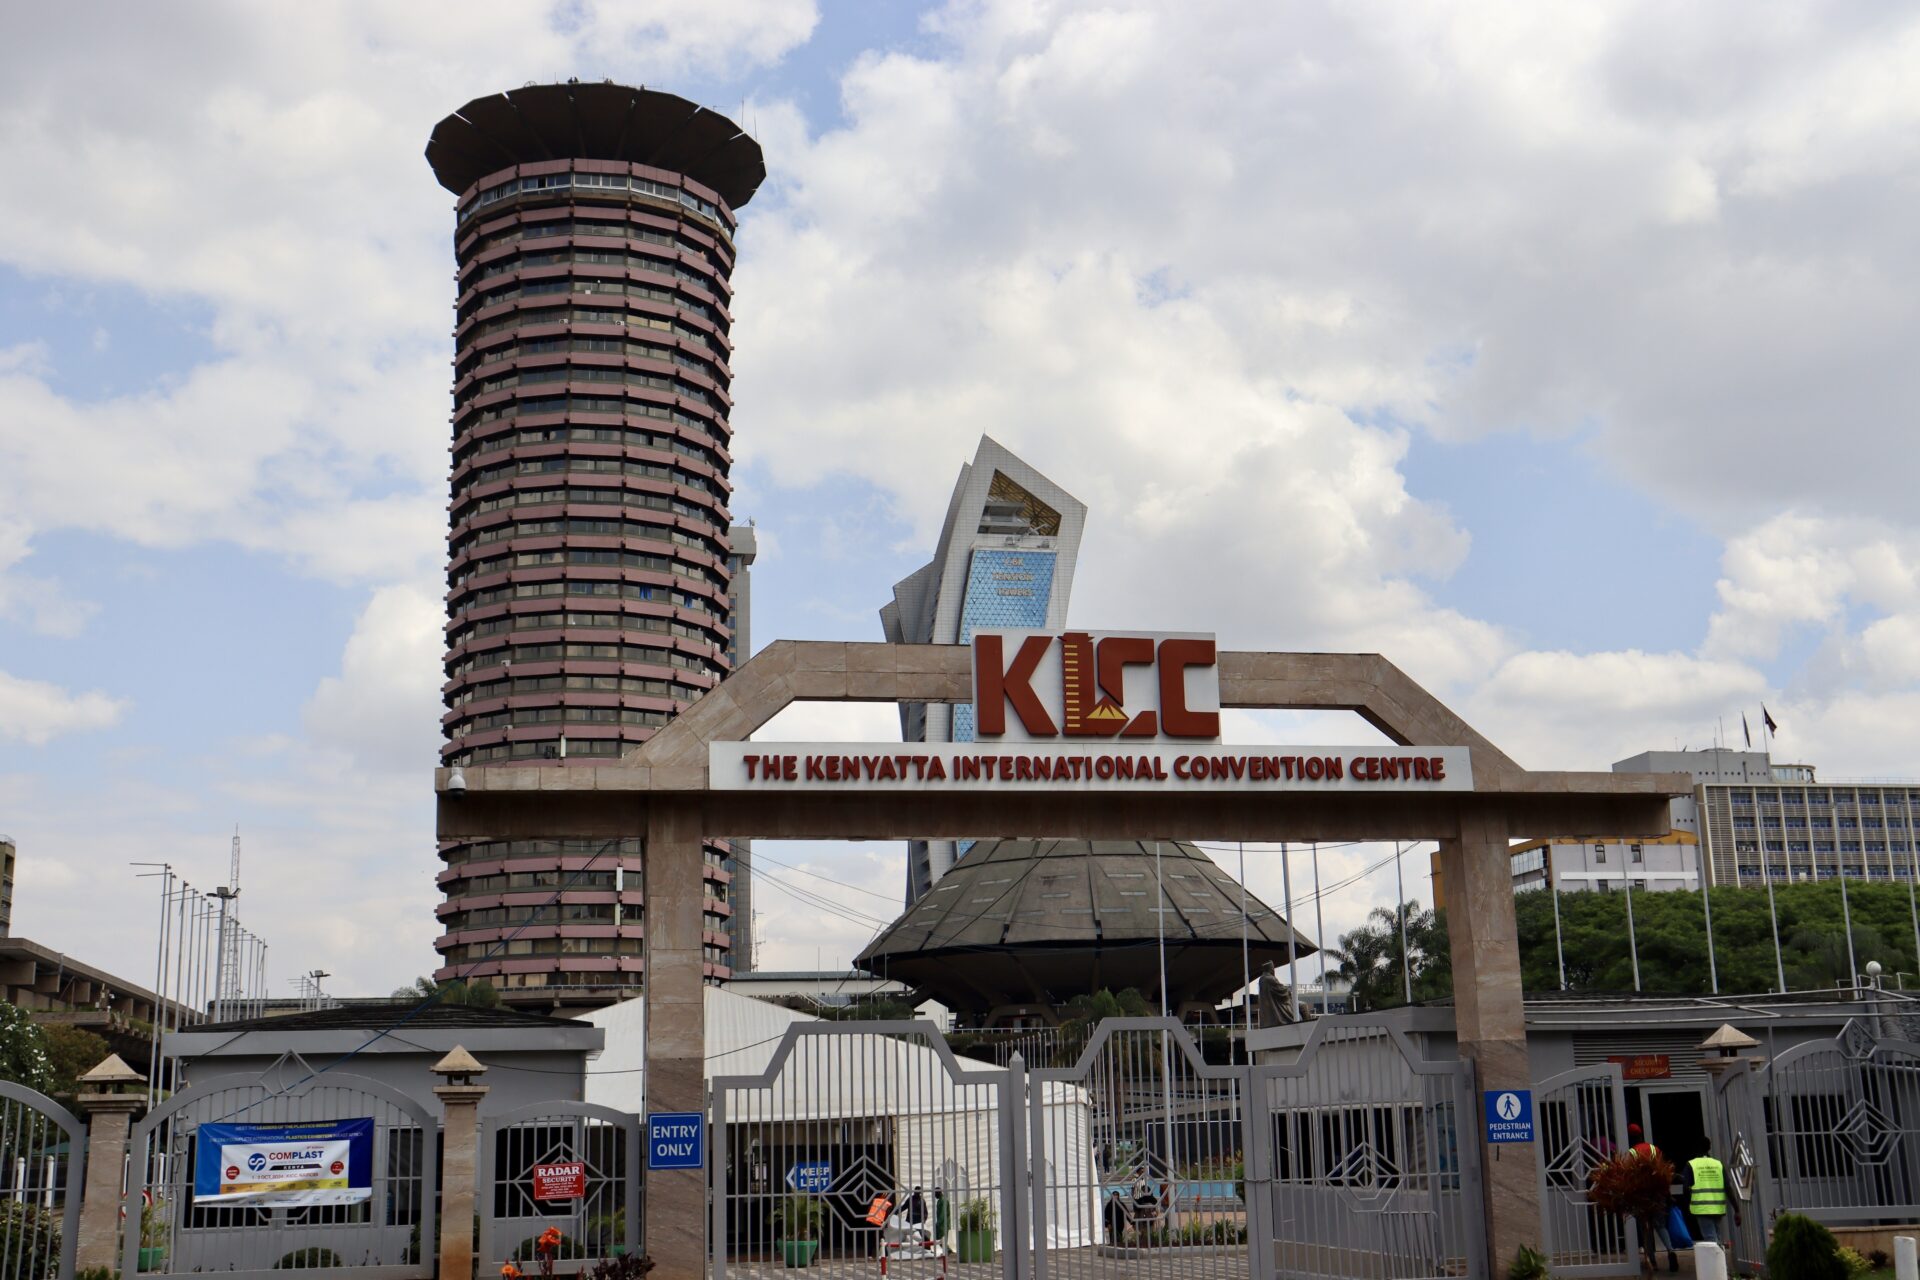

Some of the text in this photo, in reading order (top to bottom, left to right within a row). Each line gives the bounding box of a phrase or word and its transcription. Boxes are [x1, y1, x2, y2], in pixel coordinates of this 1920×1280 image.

[743, 755, 1446, 781] THE KENYATTA INTERNATIONAL CONVENTION CENTRE
[652, 1125, 698, 1138] ENTRY
[1489, 1122, 1531, 1131] PEDESTRIAN
[1493, 1132, 1529, 1140] ENTRANCE
[657, 1143, 694, 1156] ONLY
[269, 1150, 324, 1160] COMPLAST
[538, 1166, 581, 1177] RADAR
[800, 1167, 830, 1176] KEEP
[542, 1176, 577, 1184] SECURITY
[800, 1177, 829, 1187] LEFT
